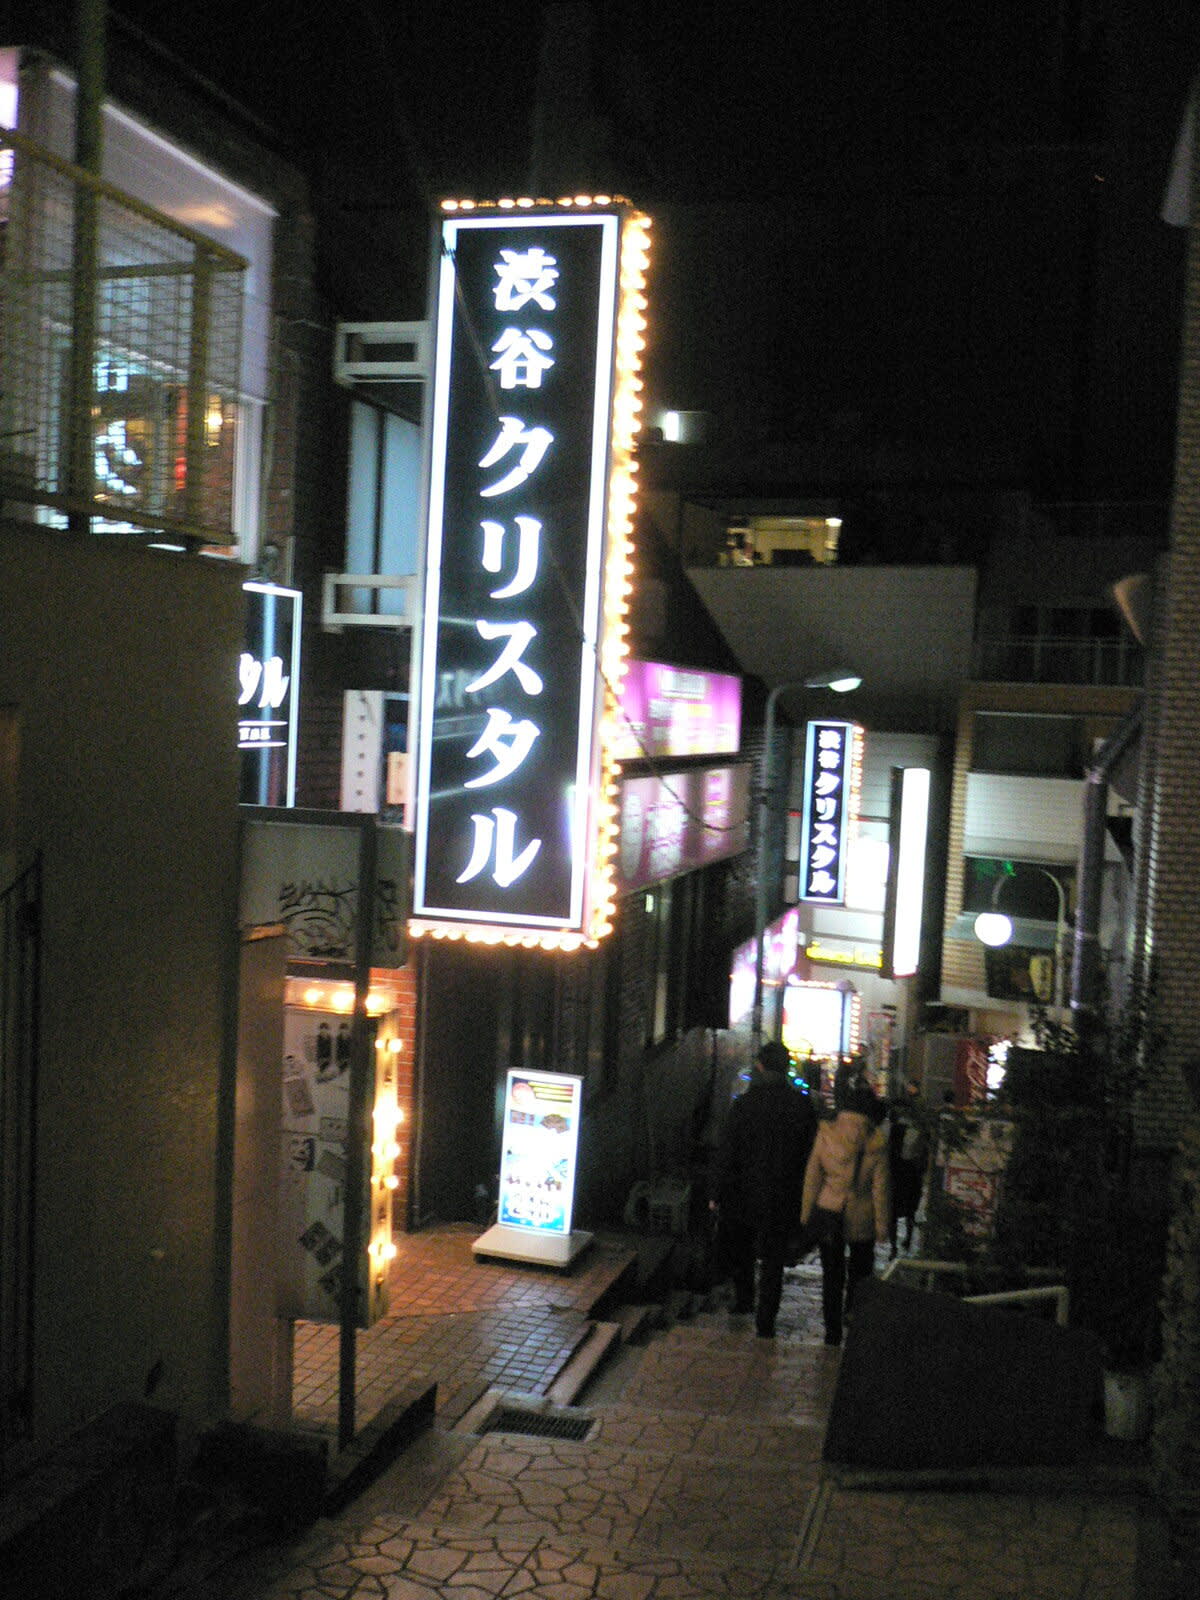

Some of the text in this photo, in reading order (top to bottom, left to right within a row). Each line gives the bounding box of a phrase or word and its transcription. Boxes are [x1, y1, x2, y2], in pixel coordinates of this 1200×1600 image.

[455, 247, 560, 889] 渋谷クリスタル
